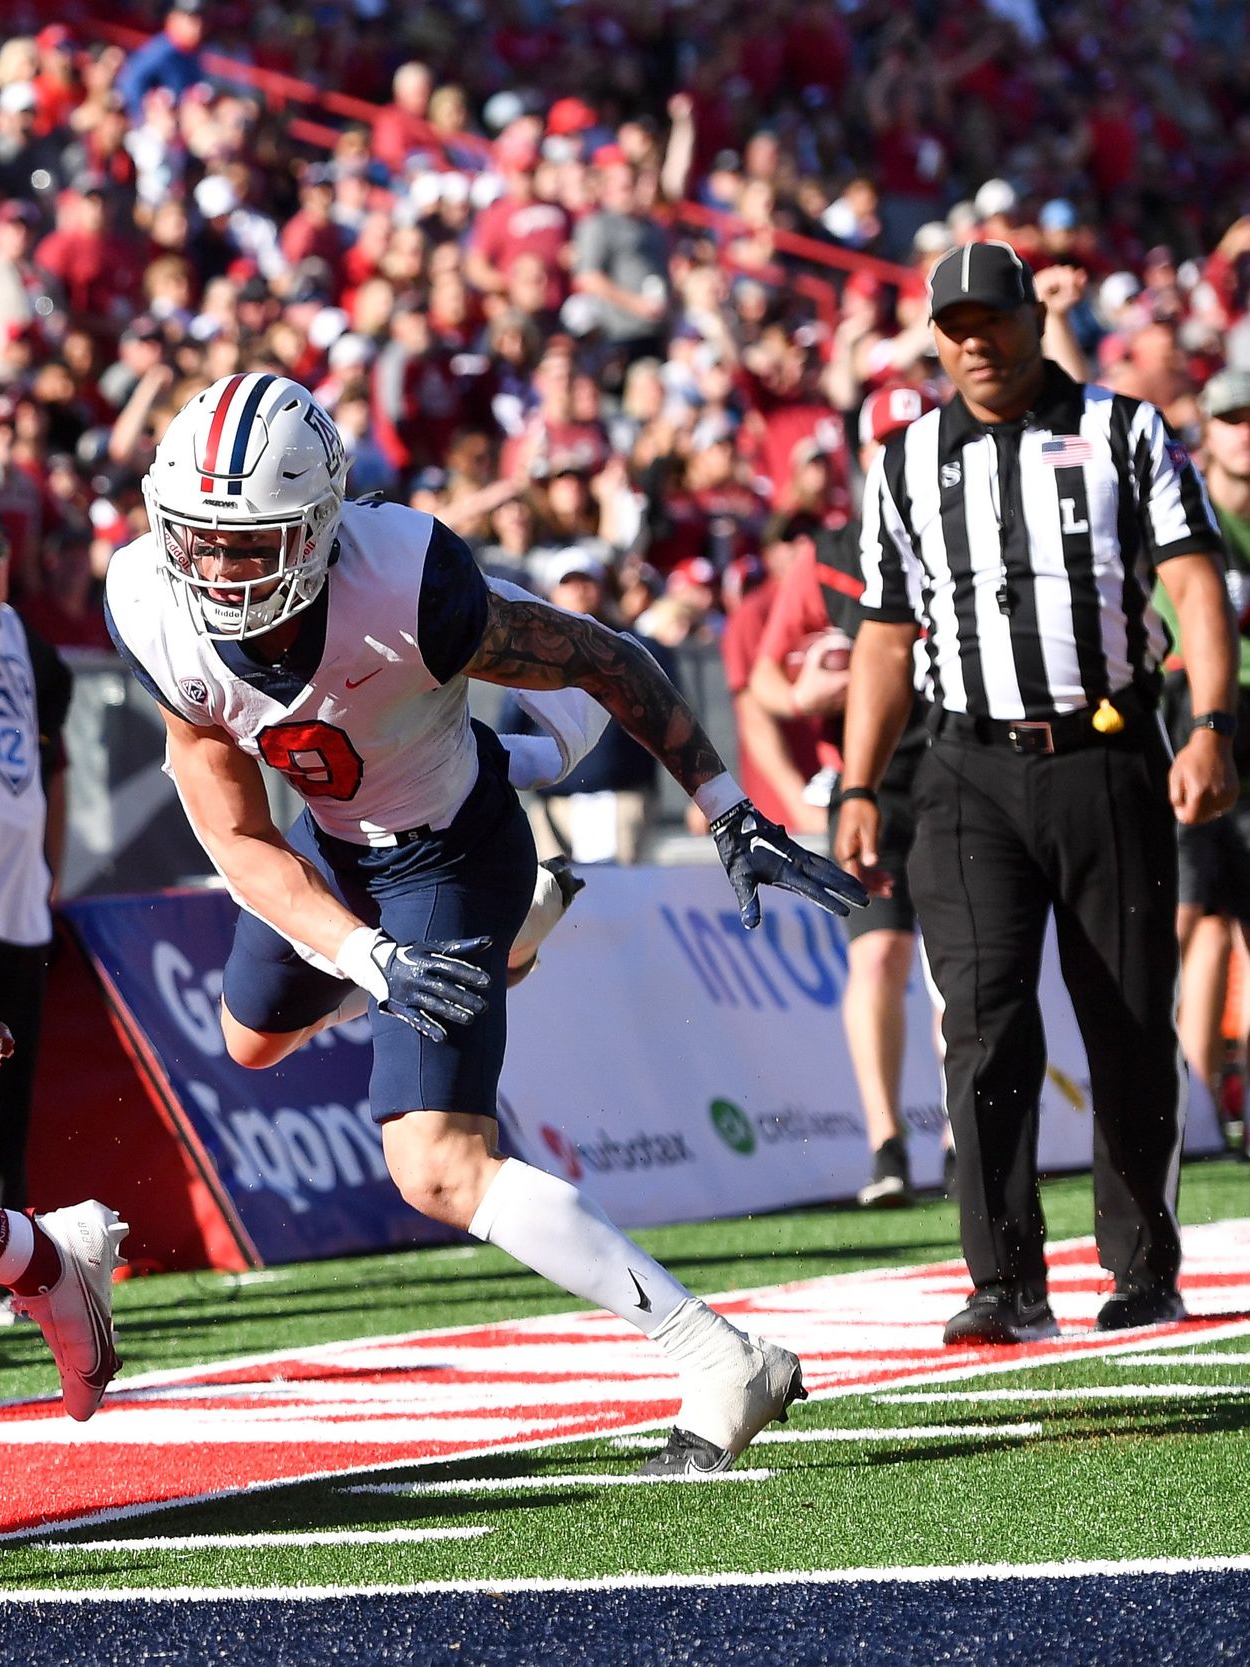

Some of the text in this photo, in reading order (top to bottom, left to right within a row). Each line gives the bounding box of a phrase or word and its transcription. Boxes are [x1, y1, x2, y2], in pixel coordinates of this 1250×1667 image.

[1059, 498, 1089, 534] L
[214, 608, 243, 618] Riddel
[188, 1079, 390, 1213] Spon
